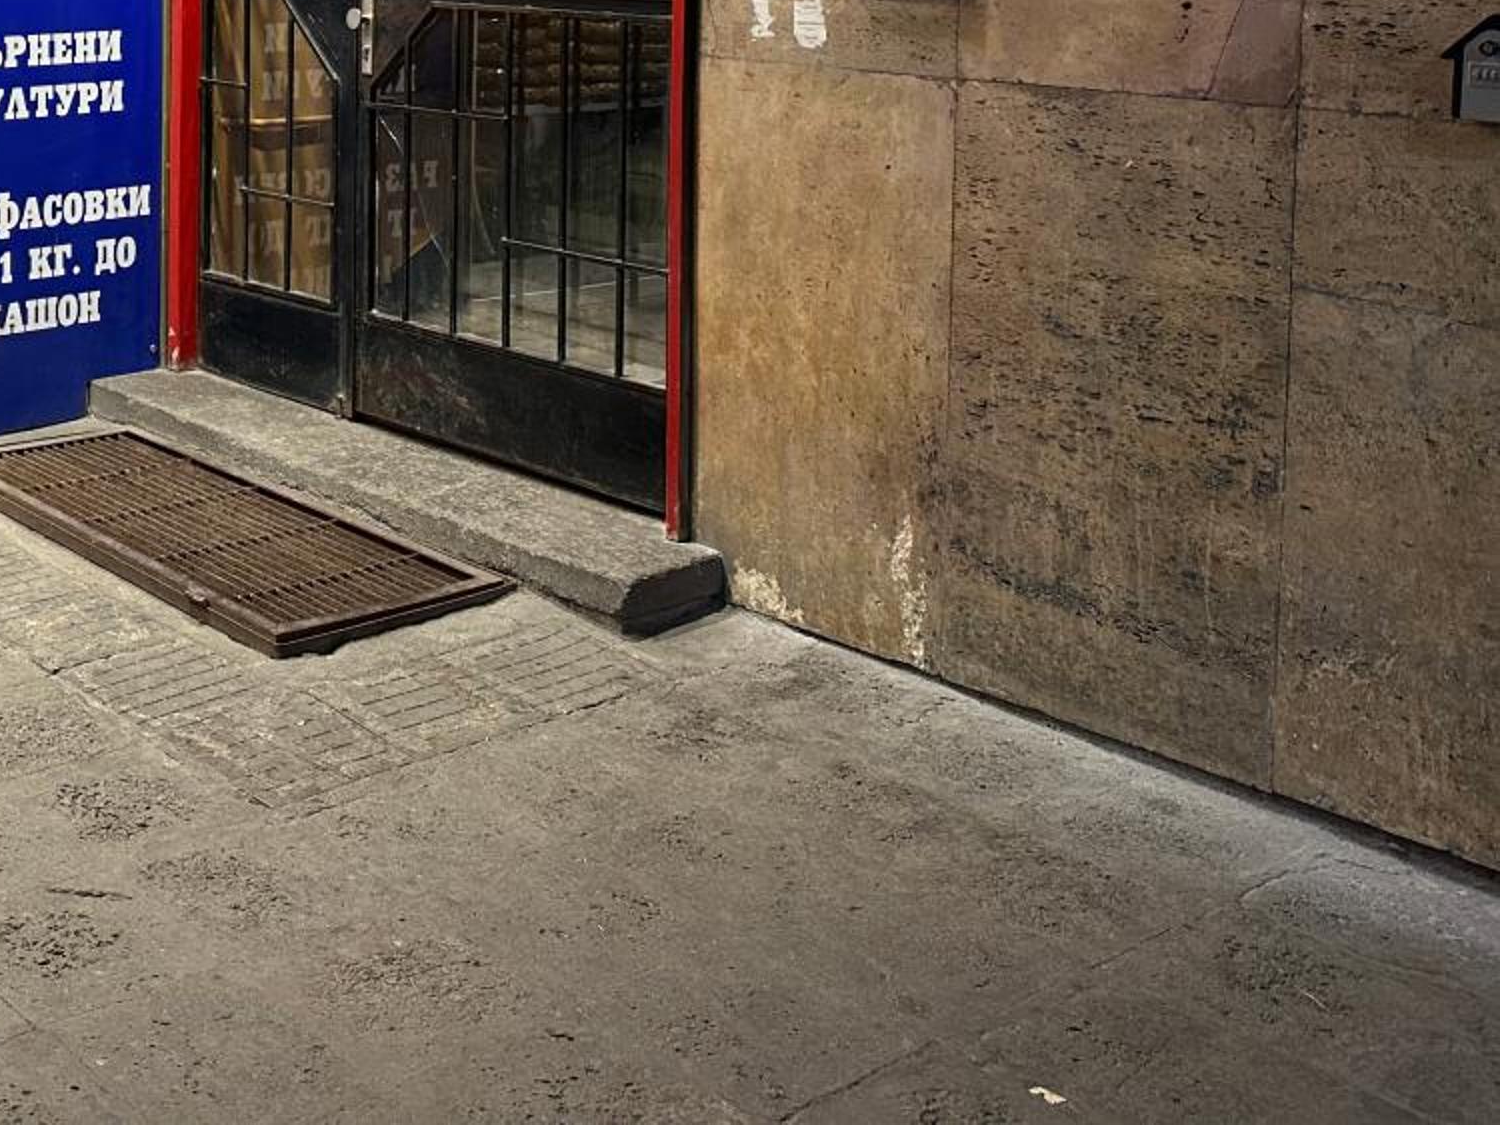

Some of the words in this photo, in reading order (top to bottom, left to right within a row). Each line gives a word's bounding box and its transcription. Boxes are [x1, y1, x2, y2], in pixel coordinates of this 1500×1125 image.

[0, 251, 13, 284] 1
[28, 243, 80, 280] КГ.
[95, 236, 136, 275] ДО
